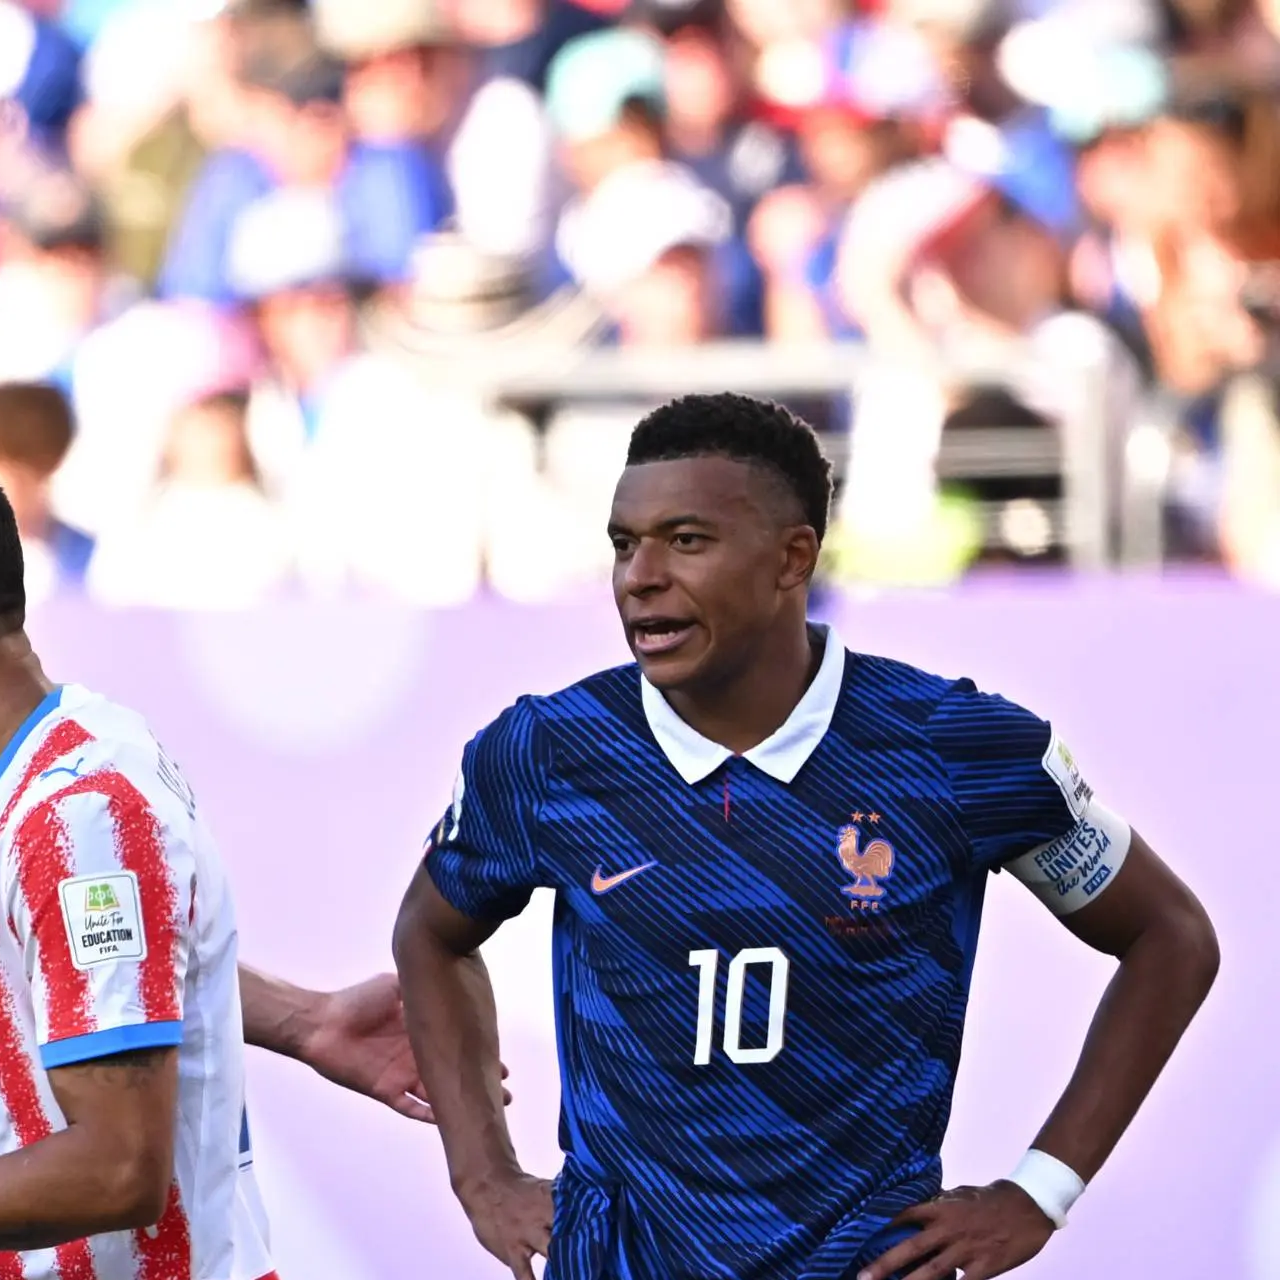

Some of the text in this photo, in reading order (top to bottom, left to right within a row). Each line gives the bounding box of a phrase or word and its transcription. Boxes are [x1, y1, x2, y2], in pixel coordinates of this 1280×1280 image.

[1034, 818, 1085, 868] FOOTBAL
[1042, 822, 1096, 882] UNITES
[1055, 873, 1080, 896] the
[1078, 830, 1111, 878] World
[1083, 866, 1110, 894] FIFA
[81, 928, 133, 948] EDUCATION
[100, 945, 118, 954] FIFA
[687, 946, 789, 1066] 10
